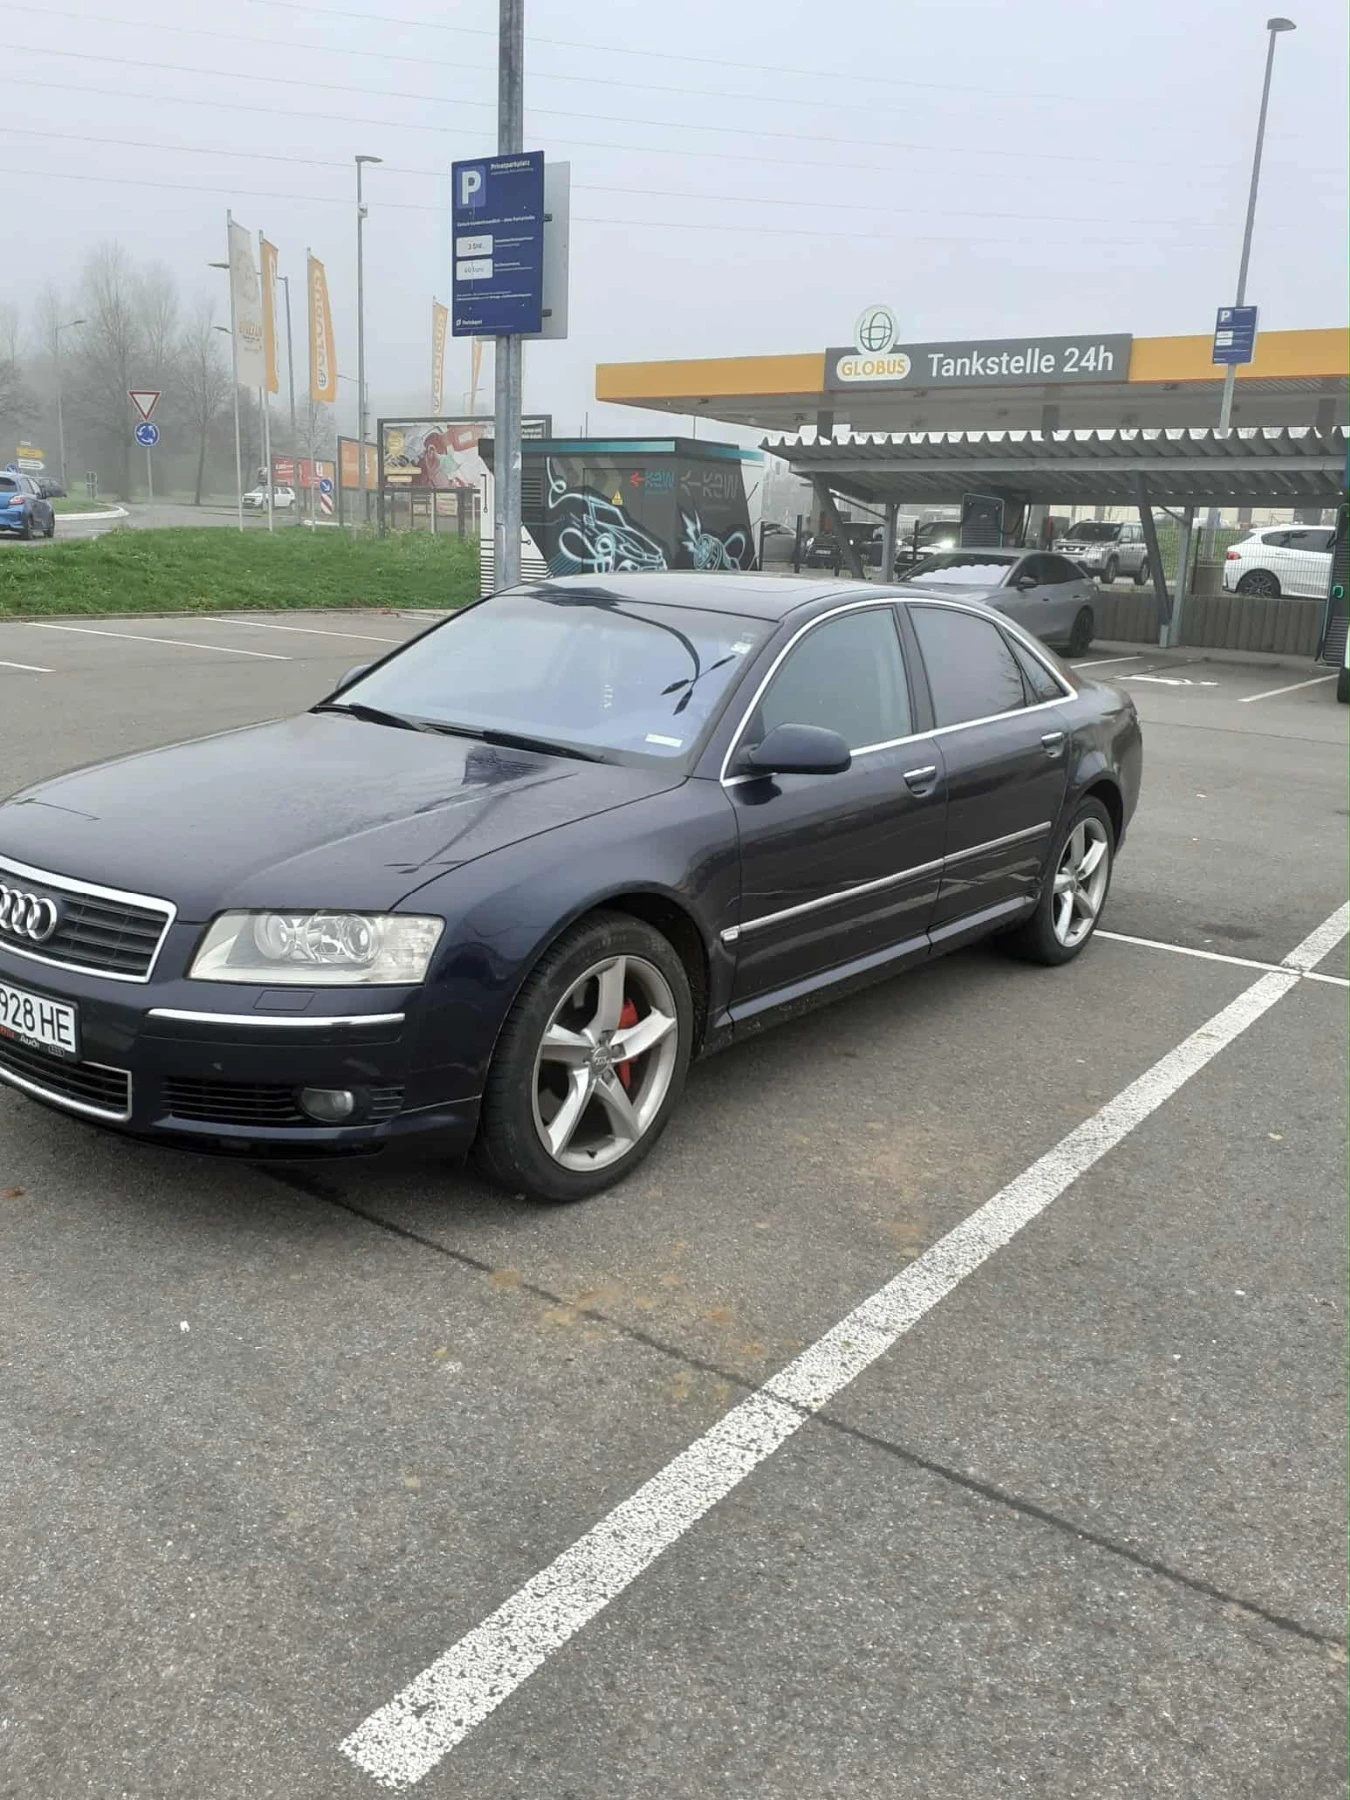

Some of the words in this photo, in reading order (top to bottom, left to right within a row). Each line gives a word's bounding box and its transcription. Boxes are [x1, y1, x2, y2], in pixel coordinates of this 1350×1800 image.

[461, 170, 482, 205] P
[841, 358, 907, 377] GLOBUS
[927, 347, 1056, 378] Tankstelle
[1062, 344, 1114, 373] 24h
